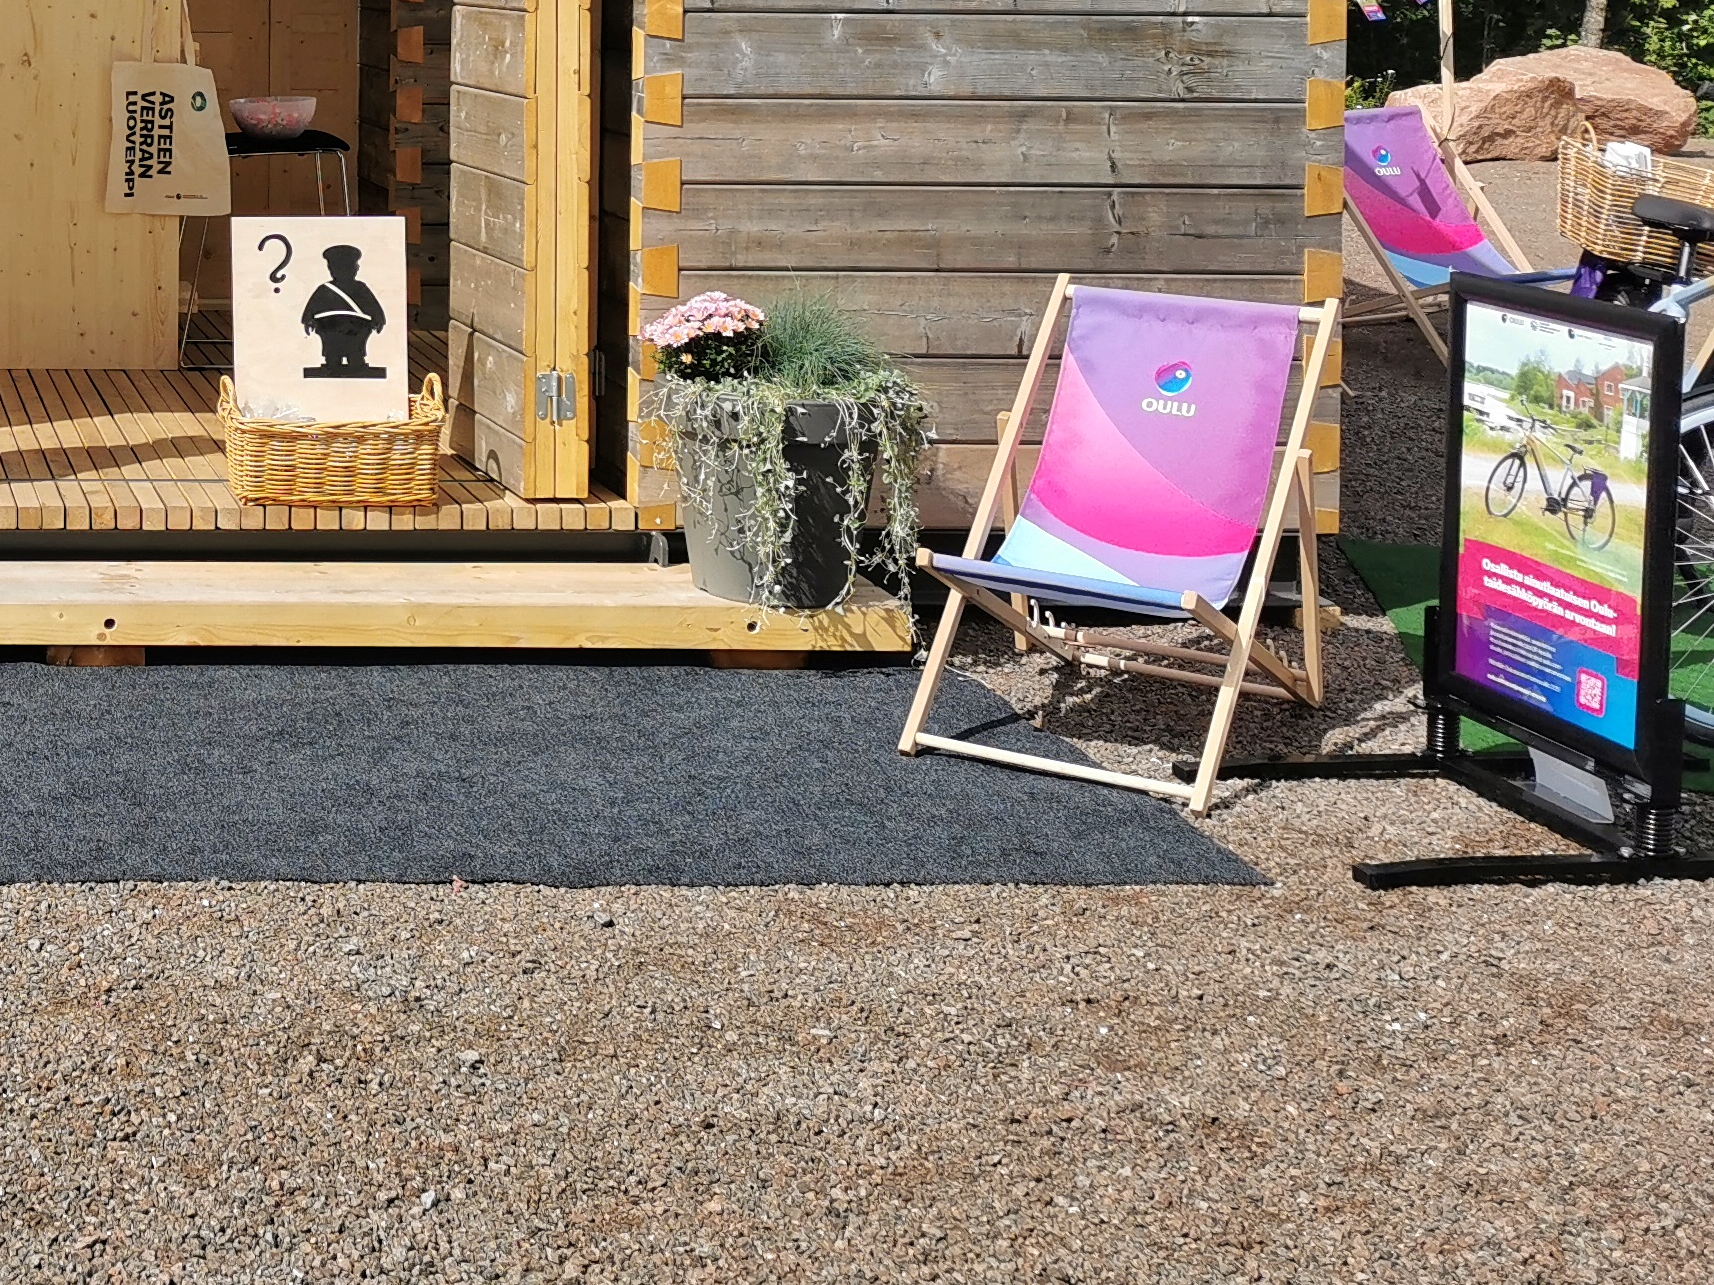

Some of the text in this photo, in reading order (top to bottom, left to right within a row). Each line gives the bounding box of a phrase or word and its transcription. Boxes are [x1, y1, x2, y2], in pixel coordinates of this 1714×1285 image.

[124, 91, 138, 197] LUOVEMPI
[138, 91, 156, 179] VERRAN
[157, 91, 174, 175] ASTEEN
[1375, 167, 1401, 175] OULU
[1141, 398, 1195, 416] OULU
[1482, 558, 1523, 582] Osallistu
[1524, 575, 1589, 609] ainutlaatuisen
[1590, 599, 1617, 619] Oulu-
[1483, 576, 1617, 637] taidesähköpyörän arvontaan!
